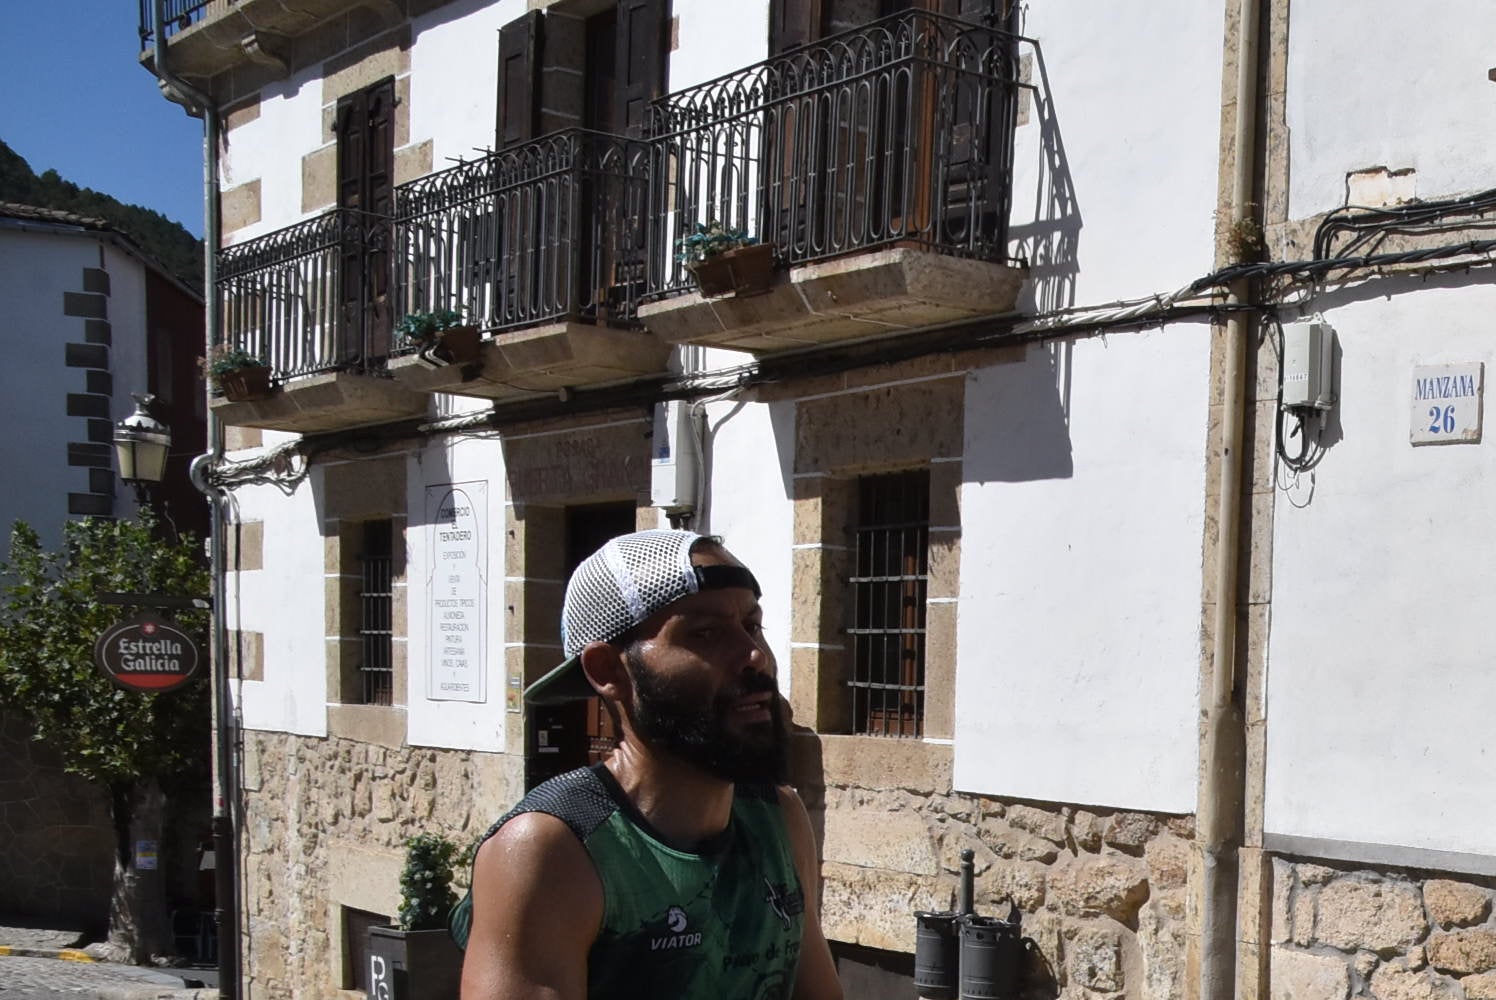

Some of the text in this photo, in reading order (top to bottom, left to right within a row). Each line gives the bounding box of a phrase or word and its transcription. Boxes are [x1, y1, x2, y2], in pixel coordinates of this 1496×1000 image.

[1415, 374, 1475, 401] MANZANA
[1428, 404, 1456, 434] 26
[439, 530, 472, 542] TENTADERO
[118, 638, 182, 655] Estrella
[121, 654, 180, 671] Galicia
[651, 932, 702, 951] VIATOR
